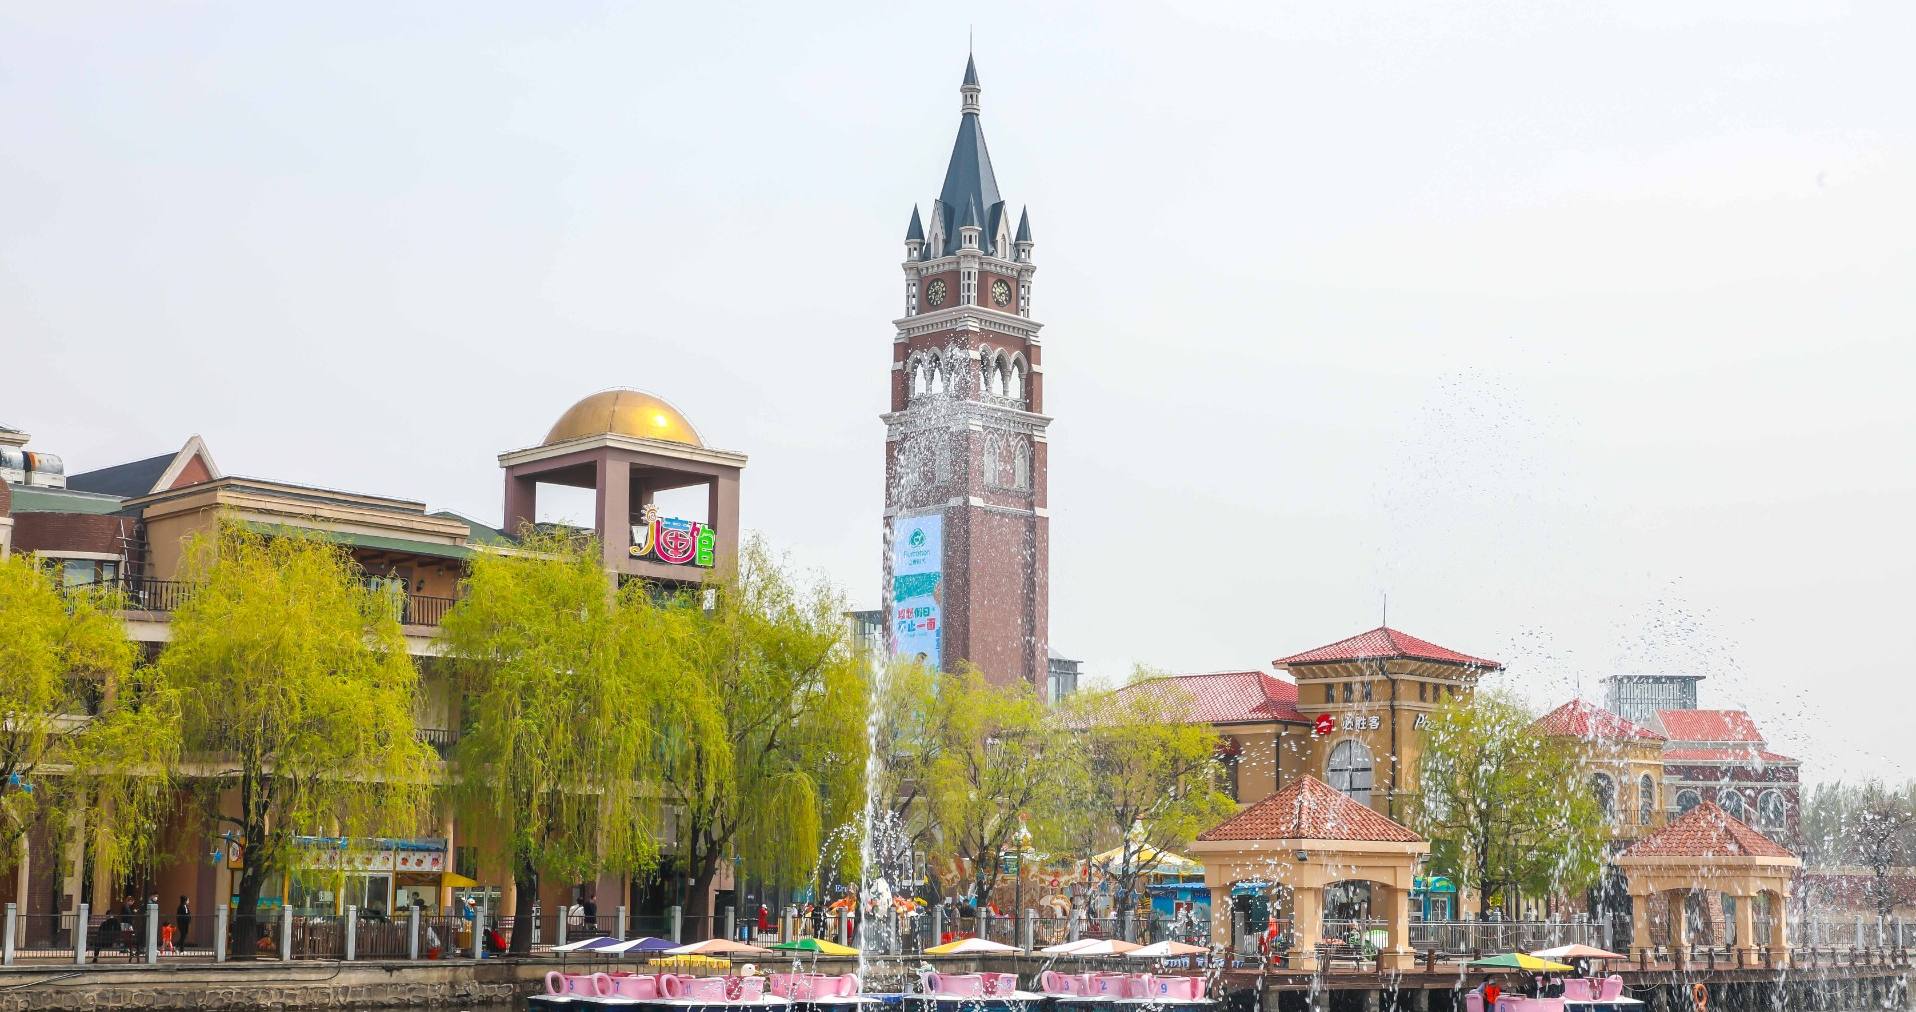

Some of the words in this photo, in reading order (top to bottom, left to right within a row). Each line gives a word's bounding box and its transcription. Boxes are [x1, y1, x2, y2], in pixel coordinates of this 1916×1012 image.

[1342, 713, 1380, 730] 必胜客
[569, 980, 574, 990] 5
[615, 981, 620, 991] 7
[1064, 980, 1070, 991] 3
[1101, 980, 1108, 991] 2
[1160, 983, 1168, 994] 9
